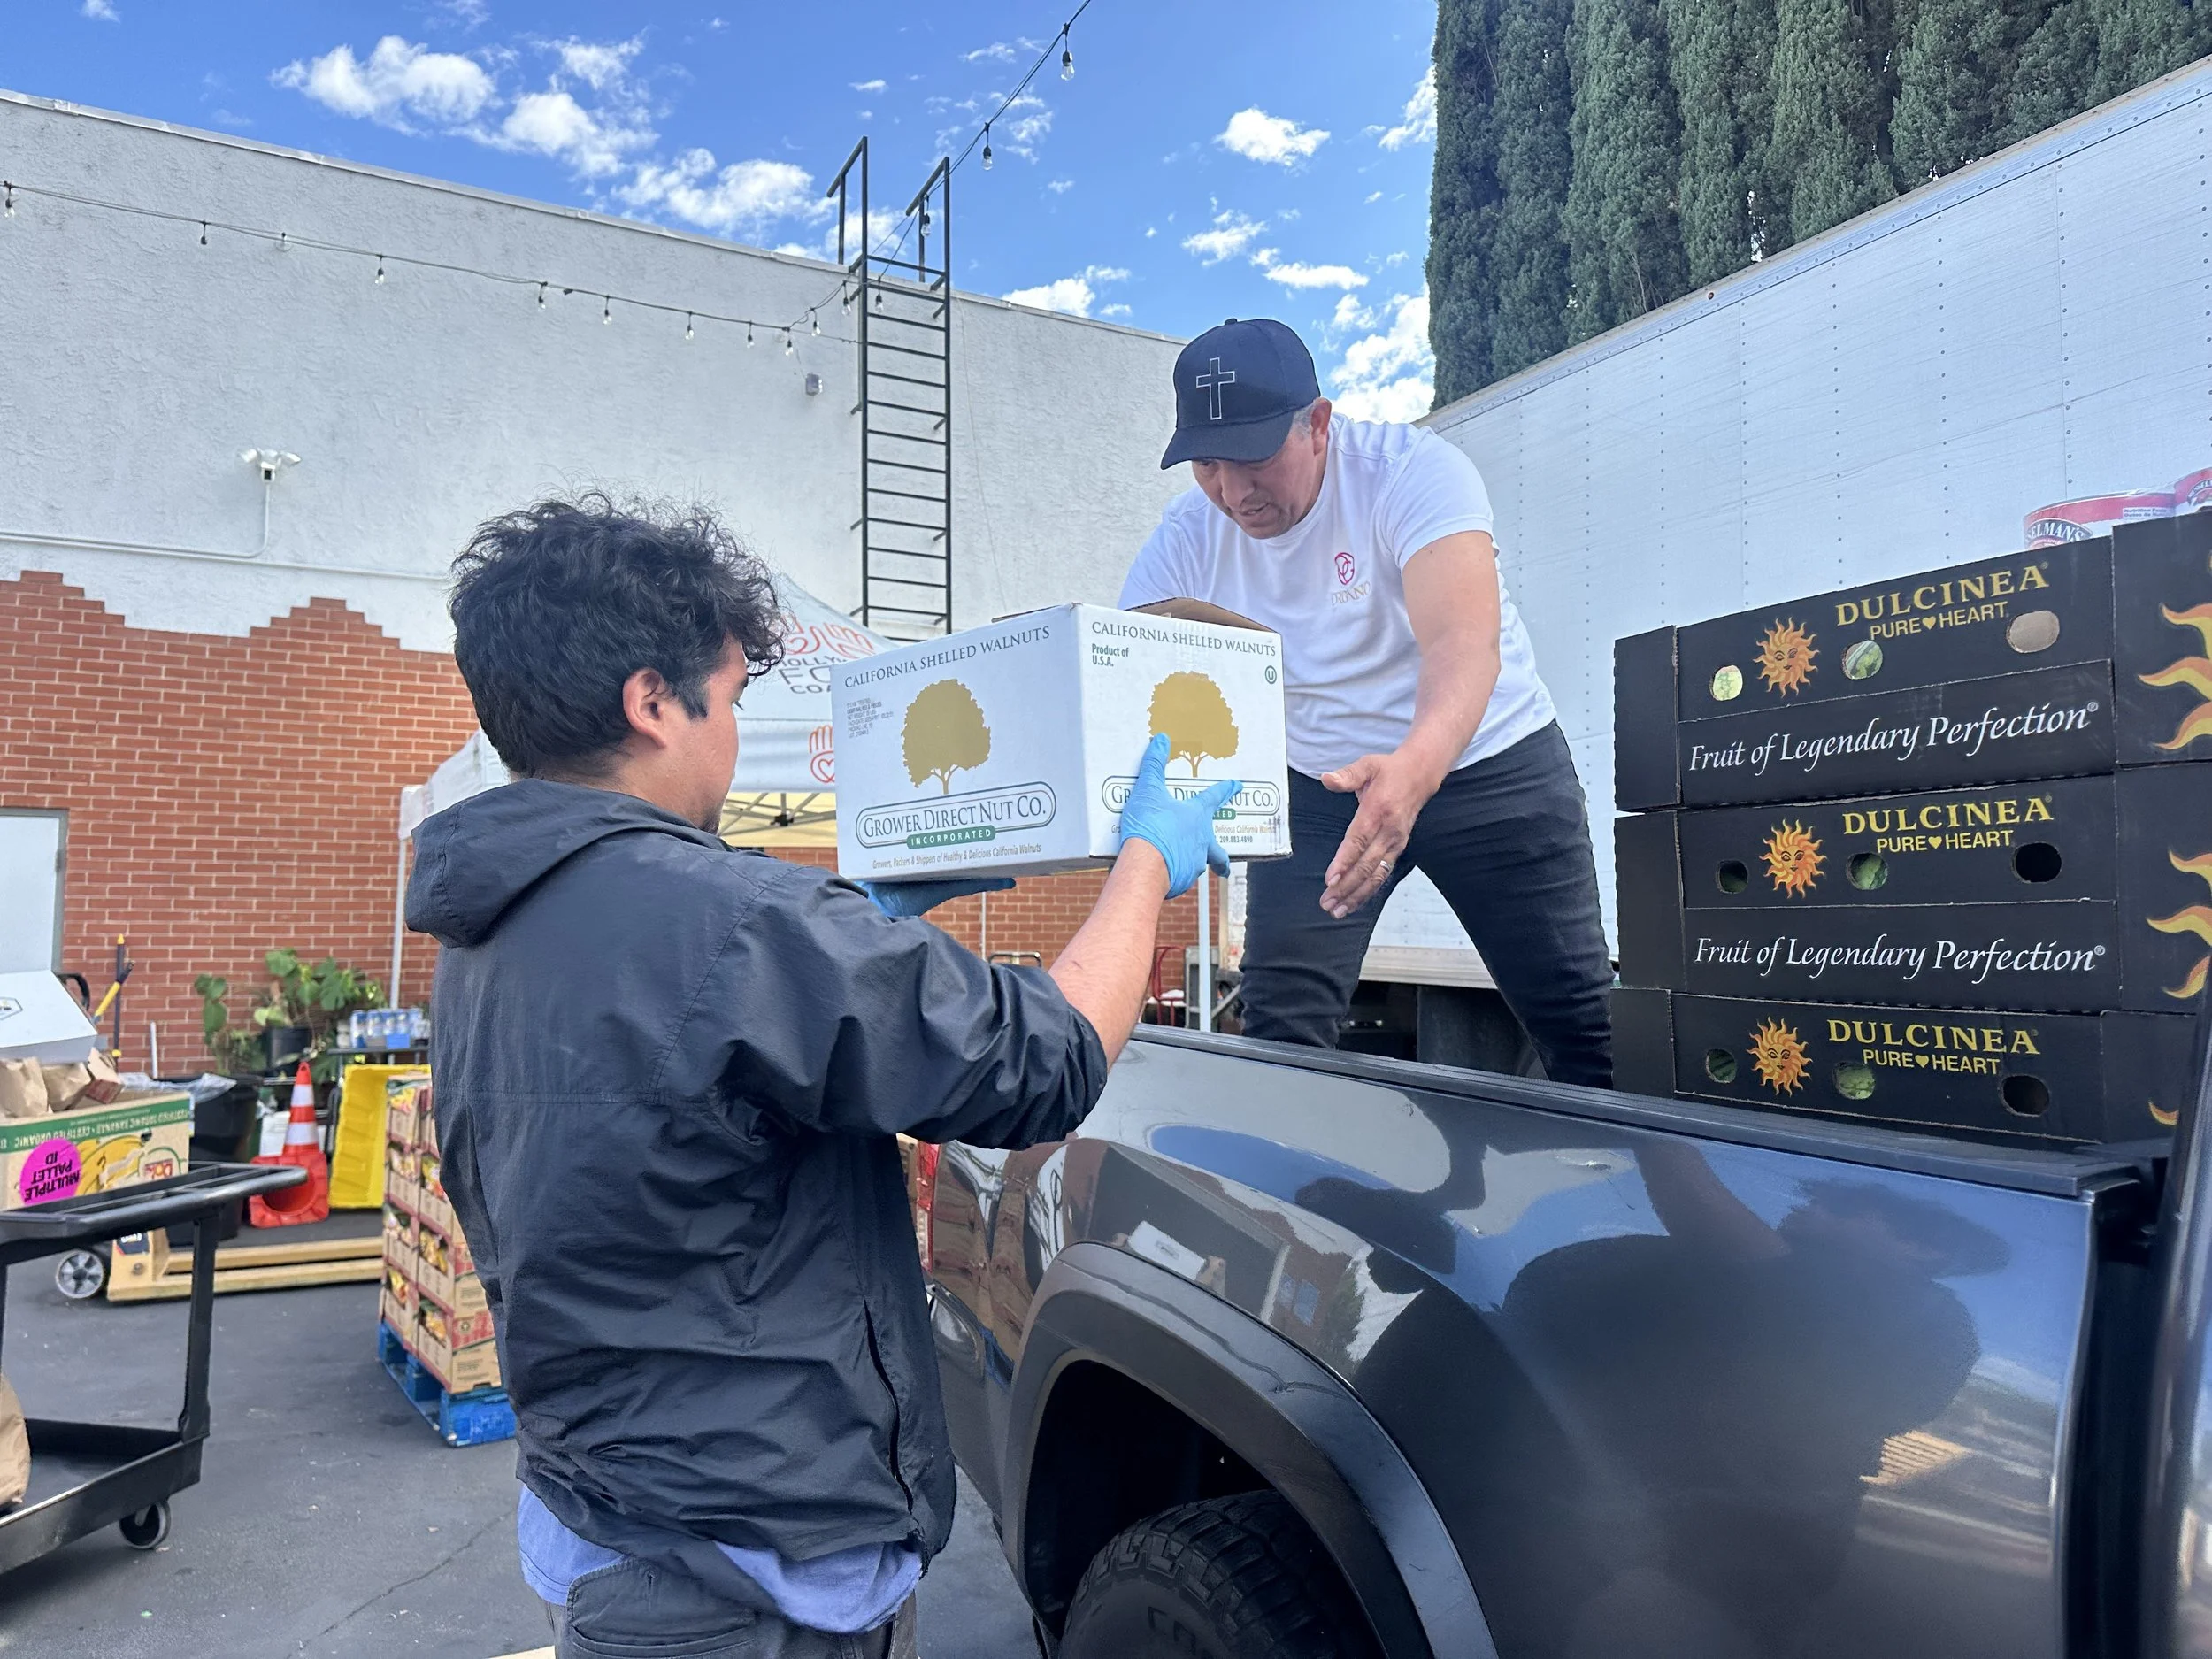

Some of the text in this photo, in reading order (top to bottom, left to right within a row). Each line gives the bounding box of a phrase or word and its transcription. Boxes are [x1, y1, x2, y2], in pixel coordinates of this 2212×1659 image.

[1835, 565, 2049, 626] DULCINEA
[1870, 601, 2008, 640] PURE HEART
[1092, 621, 1276, 657] CALIFORNIA SHELLED WALNUTS
[1092, 643, 1129, 657] Product of
[845, 626, 1050, 688] CALIFORNIA SHELLED WALNUTS
[1092, 656, 1114, 667] U.S.A.
[1689, 742, 1746, 771] Fruit
[1751, 733, 1779, 777] of
[1780, 722, 1919, 772] Legendary
[1252, 790, 1274, 807] CO.
[864, 795, 1047, 838] GROWER DIRECT NUT CO.
[1237, 825, 1258, 833] California
[1842, 797, 2055, 834] DULCINEA
[910, 829, 991, 846] INCORPORATED
[1877, 830, 2014, 853] PURE HEART
[893, 856, 910, 867] Packers
[911, 856, 915, 865] &
[916, 853, 936, 865] Shippers
[937, 853, 943, 863] of
[943, 850, 964, 864] Healthy
[964, 850, 968, 859] &
[968, 848, 992, 859] Delicious
[992, 845, 1018, 857] California
[1018, 842, 1041, 854] Walnuts
[1694, 938, 1752, 964] Fruit
[1757, 936, 1786, 977] of
[1786, 934, 1926, 979] Legendary
[1827, 1019, 2040, 1055] DULCINEA
[1863, 1049, 2001, 1075] PURE HEART
[31, 1159, 73, 1185] PALLET
[45, 1151, 58, 1164] ID
[25, 1170, 80, 1202] MULTIPLE
